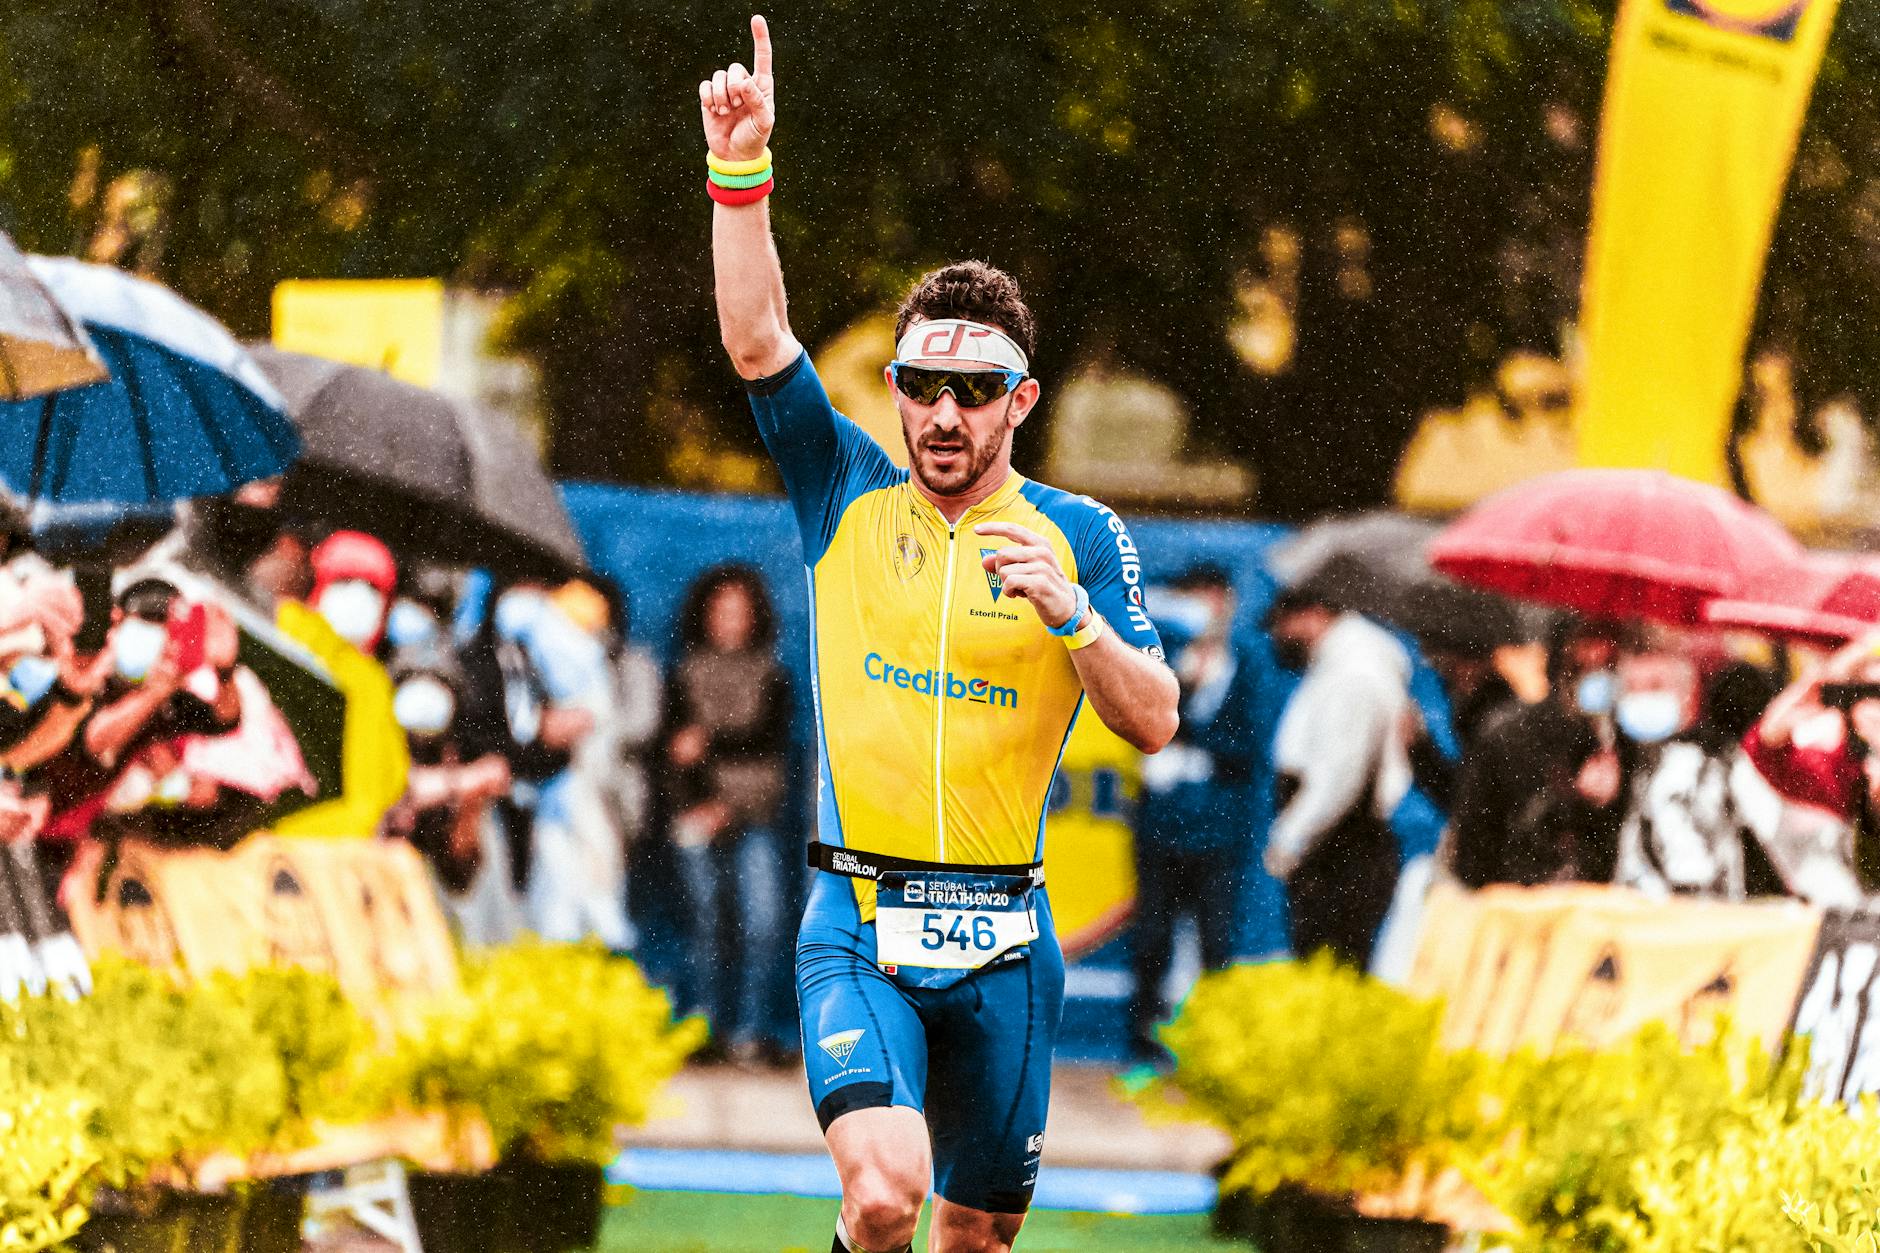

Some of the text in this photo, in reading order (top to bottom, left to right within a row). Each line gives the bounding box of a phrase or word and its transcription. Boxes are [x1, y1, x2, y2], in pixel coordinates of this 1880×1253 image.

[969, 608, 1019, 621] Estoril Praia
[864, 652, 1018, 709] Credibom
[832, 851, 859, 864] SETÚBAL
[832, 860, 878, 877] TRIATHLON
[928, 880, 968, 892] SETÚBAL
[921, 913, 997, 951] 546
